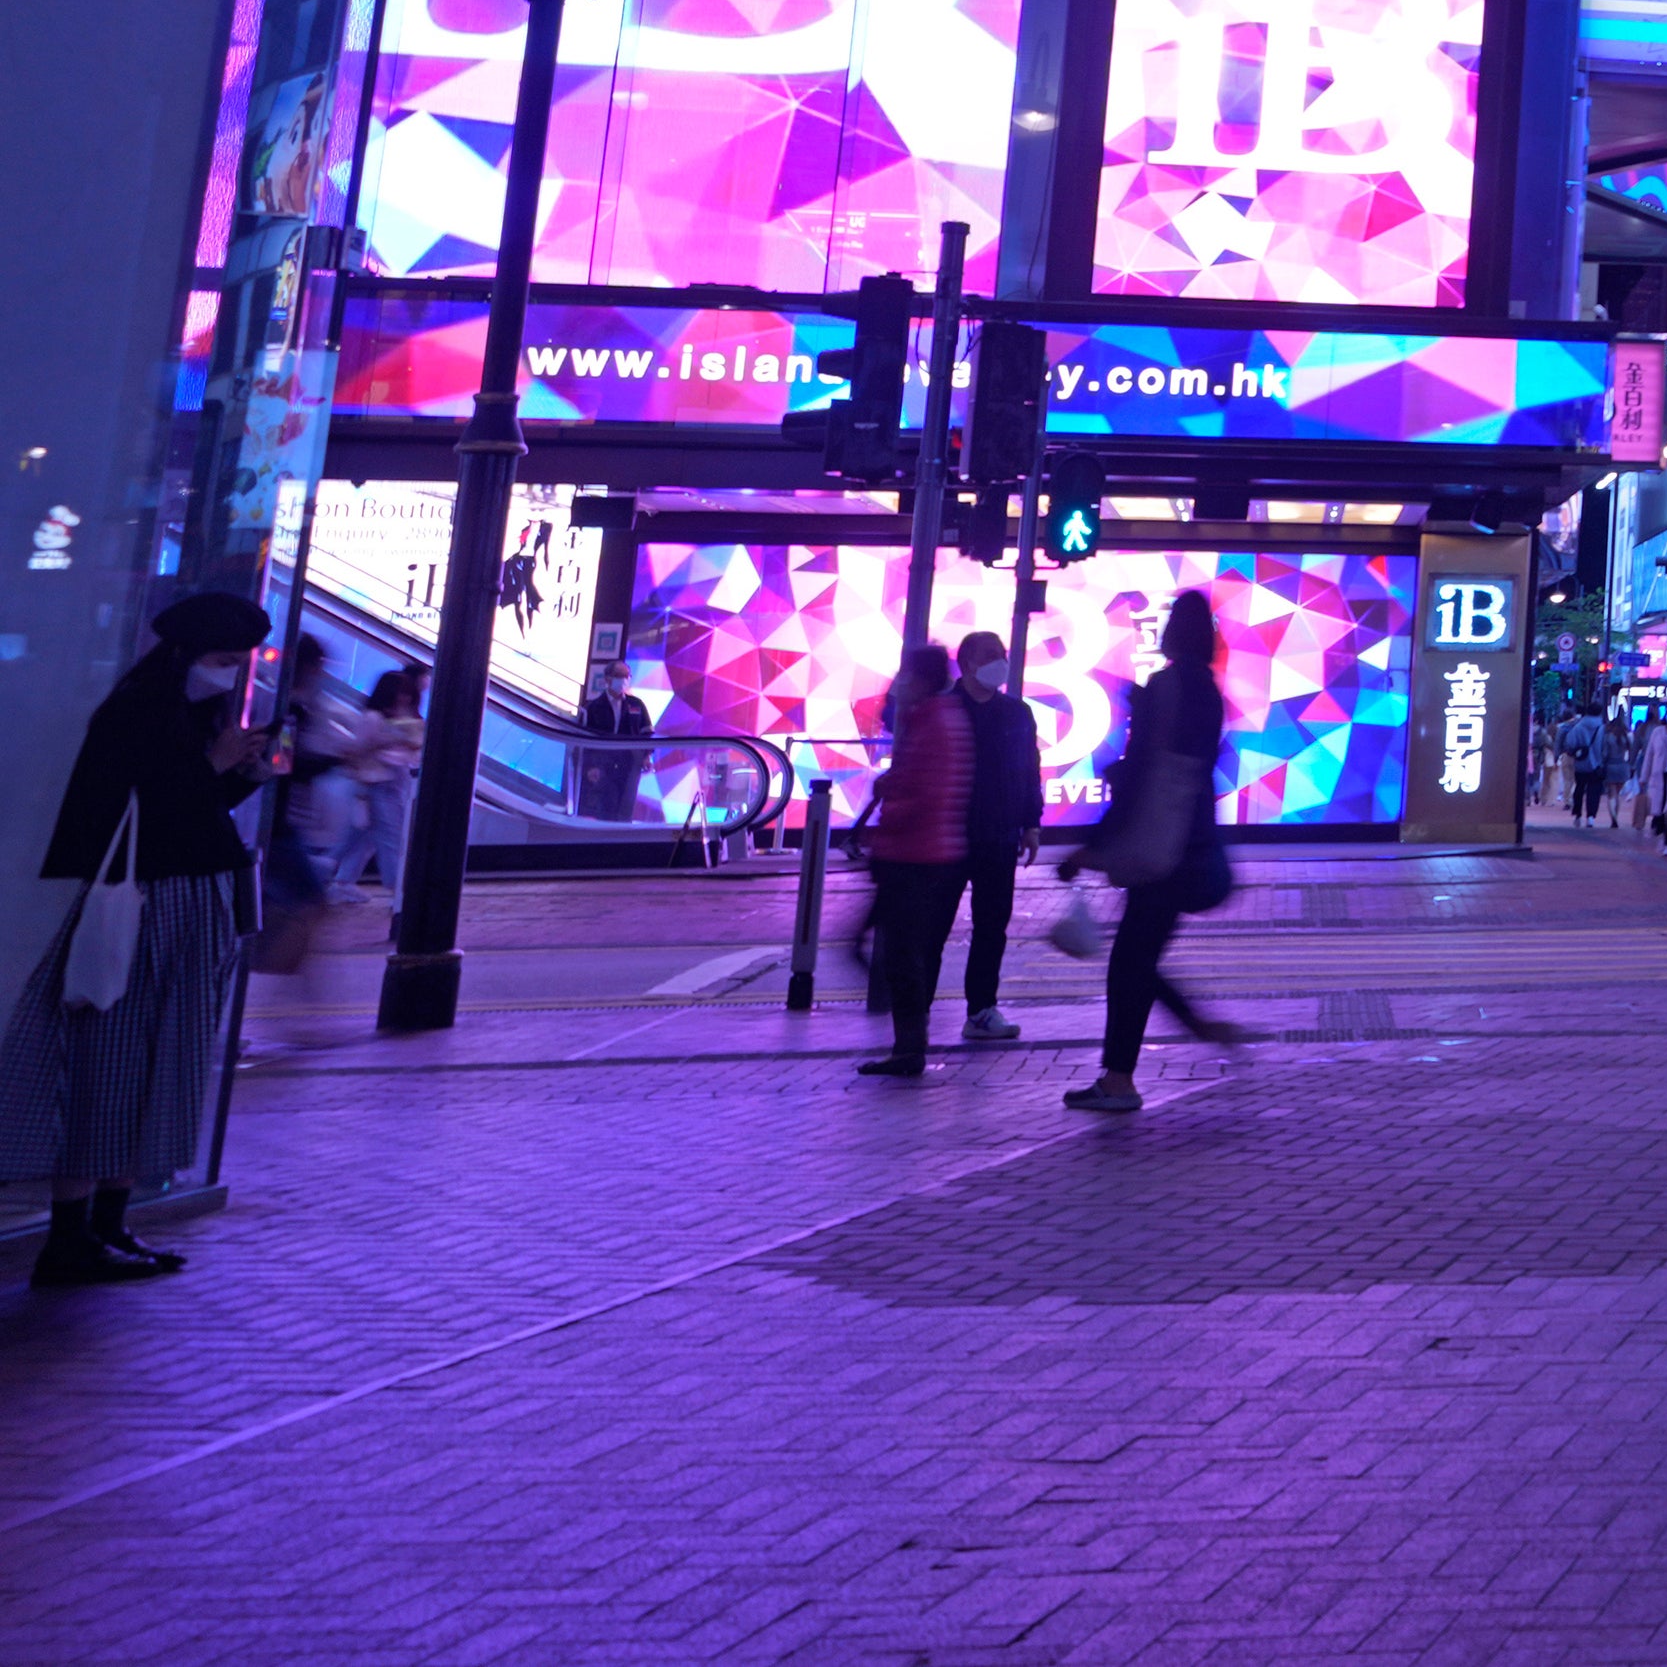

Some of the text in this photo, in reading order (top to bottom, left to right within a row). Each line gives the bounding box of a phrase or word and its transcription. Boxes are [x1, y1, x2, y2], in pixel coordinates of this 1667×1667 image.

[1622, 362, 1645, 431] 金百利
[1434, 582, 1507, 645] iB
[1437, 661, 1491, 793] 金百利
